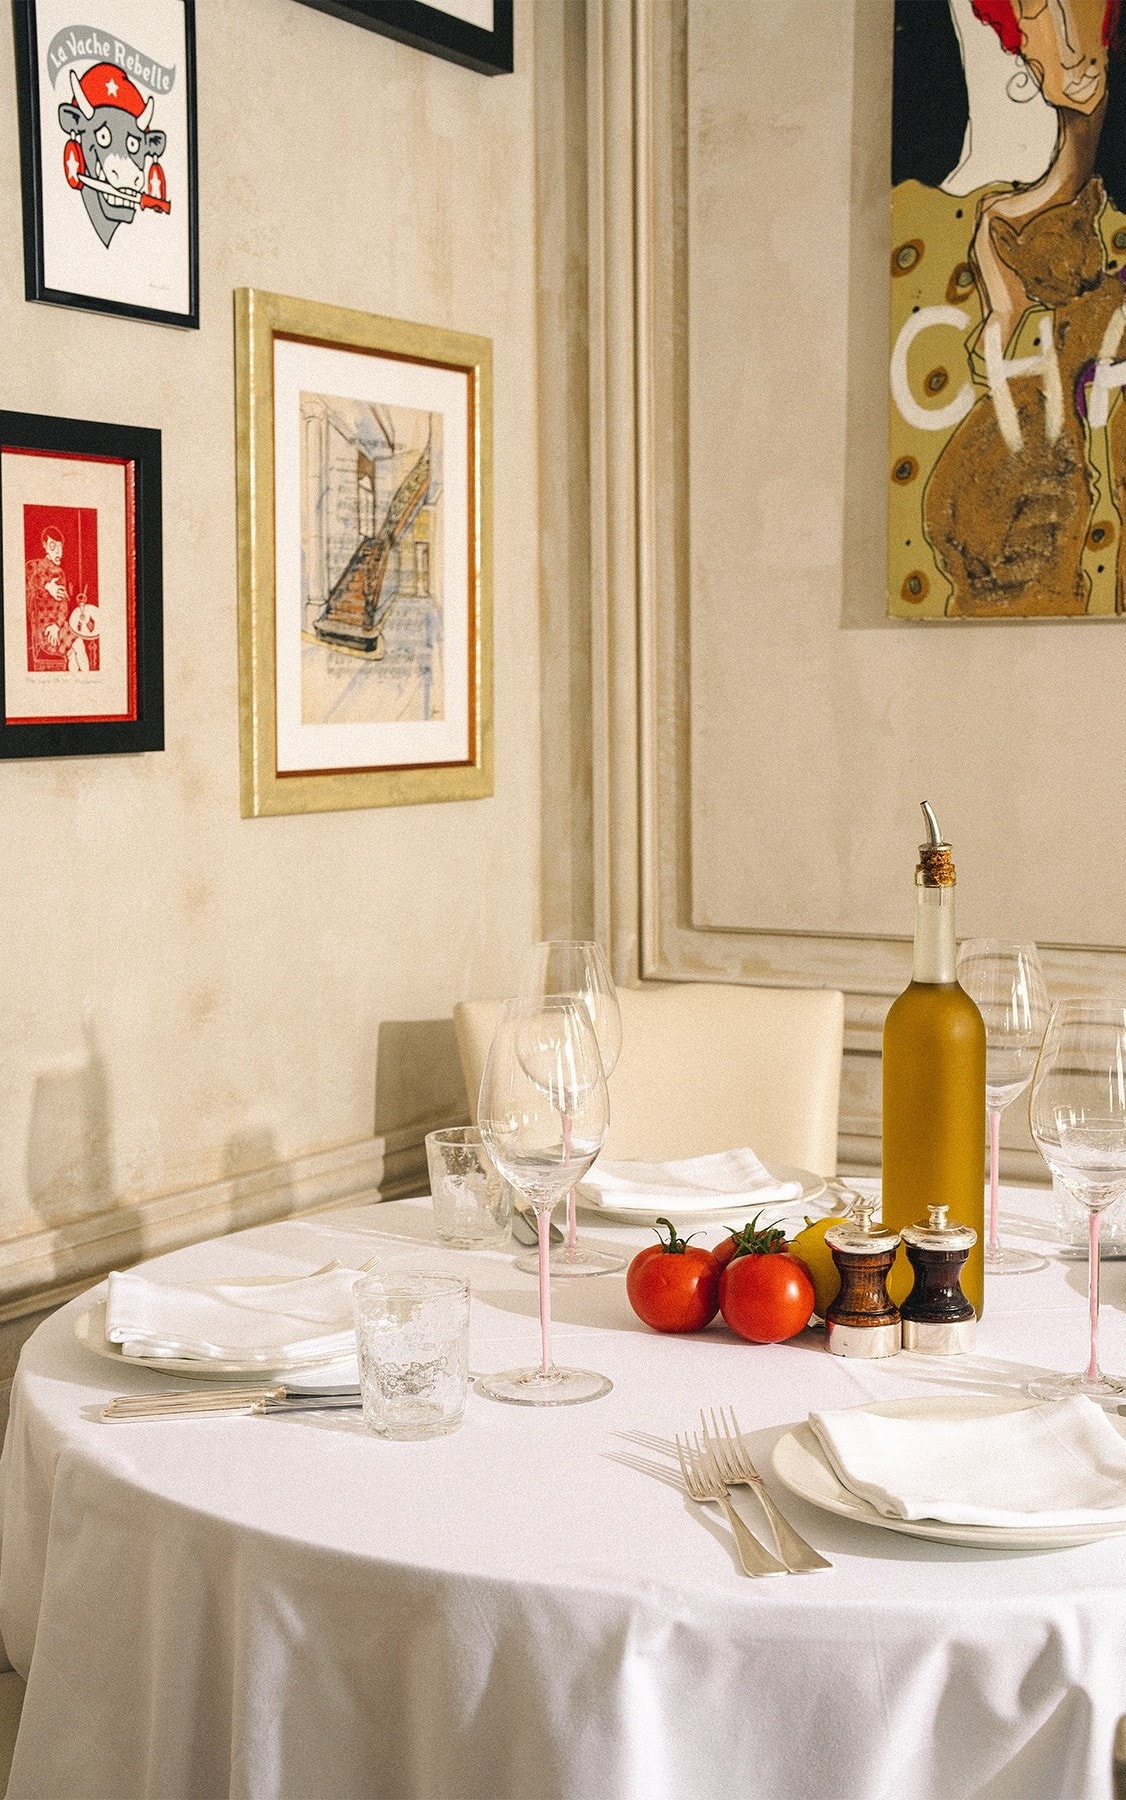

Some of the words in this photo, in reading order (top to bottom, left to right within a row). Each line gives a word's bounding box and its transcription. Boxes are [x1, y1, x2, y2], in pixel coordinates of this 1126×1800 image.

[50, 47, 68, 68] La
[65, 32, 110, 57] Vache
[114, 40, 170, 90] Rebelle
